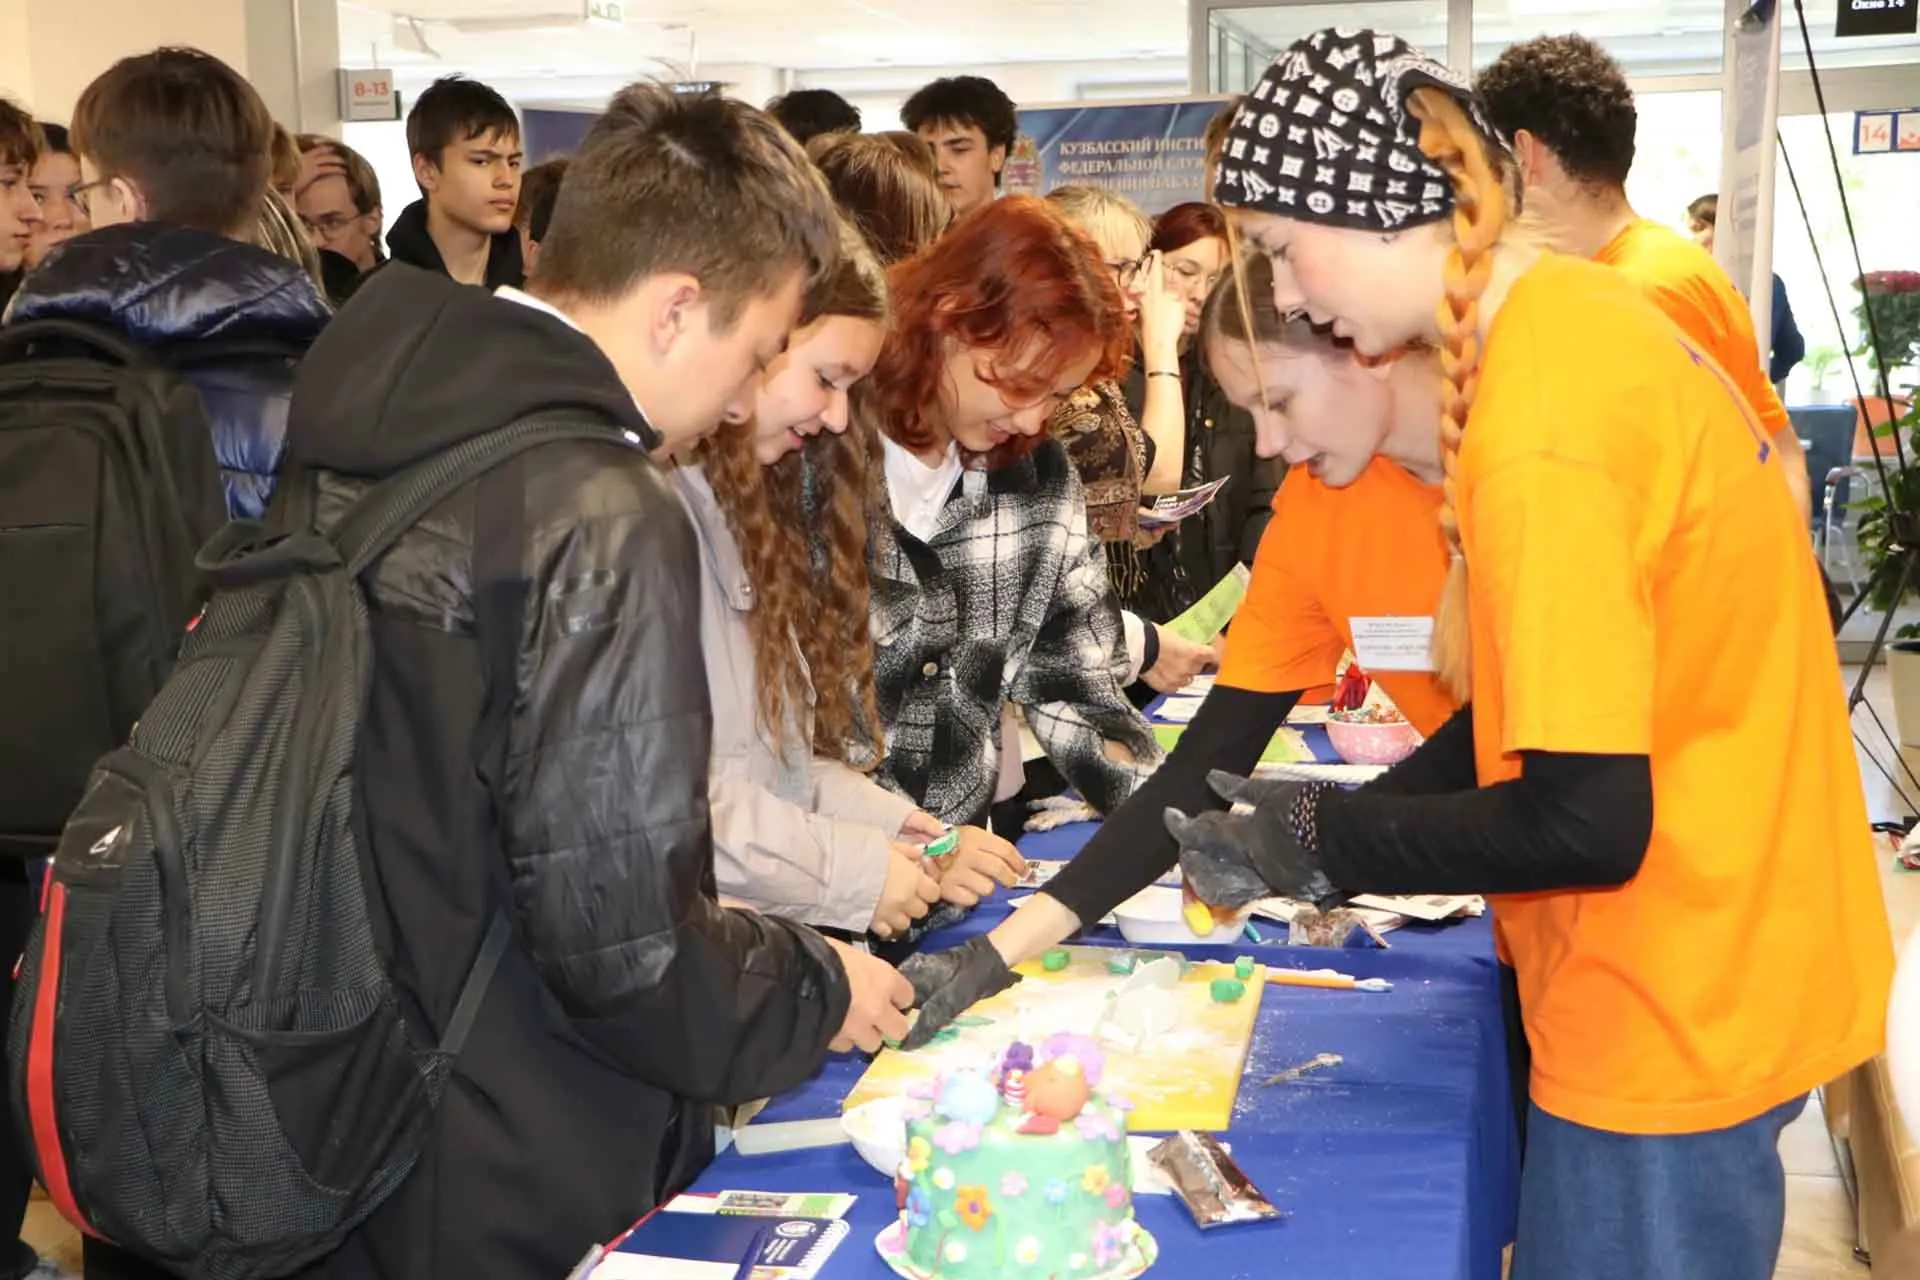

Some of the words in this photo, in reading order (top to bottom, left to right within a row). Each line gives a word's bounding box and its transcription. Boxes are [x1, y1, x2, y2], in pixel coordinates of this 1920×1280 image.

[1862, 123, 1888, 143] 14
[1060, 137, 1151, 156] КУЗБАССКИЙ
[1058, 158, 1162, 175] ФЕДЕРАЛЬНОЙ
